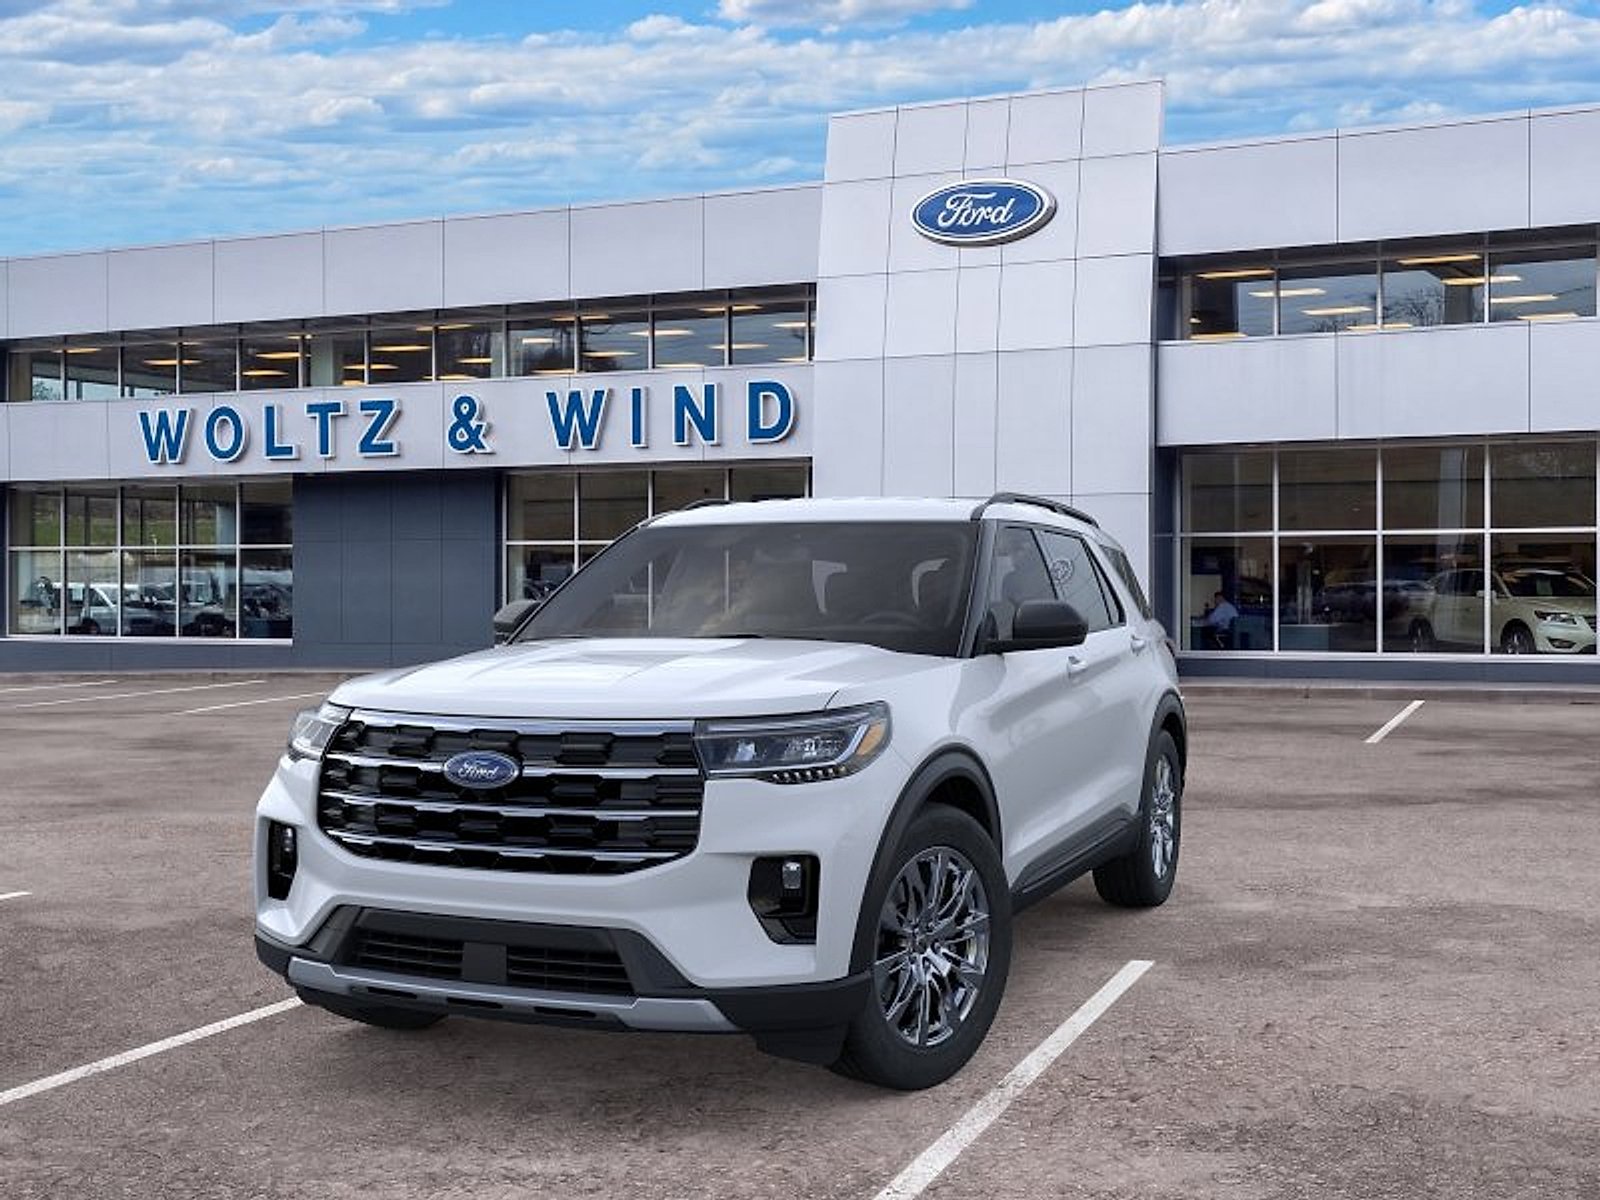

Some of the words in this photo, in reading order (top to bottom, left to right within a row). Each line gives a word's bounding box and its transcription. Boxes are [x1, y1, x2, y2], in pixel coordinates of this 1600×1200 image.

[938, 192, 1015, 227] Ford
[138, 399, 400, 464] WOLTZ
[448, 394, 493, 454] &
[546, 380, 796, 450] WIND
[458, 760, 500, 779] Ford
